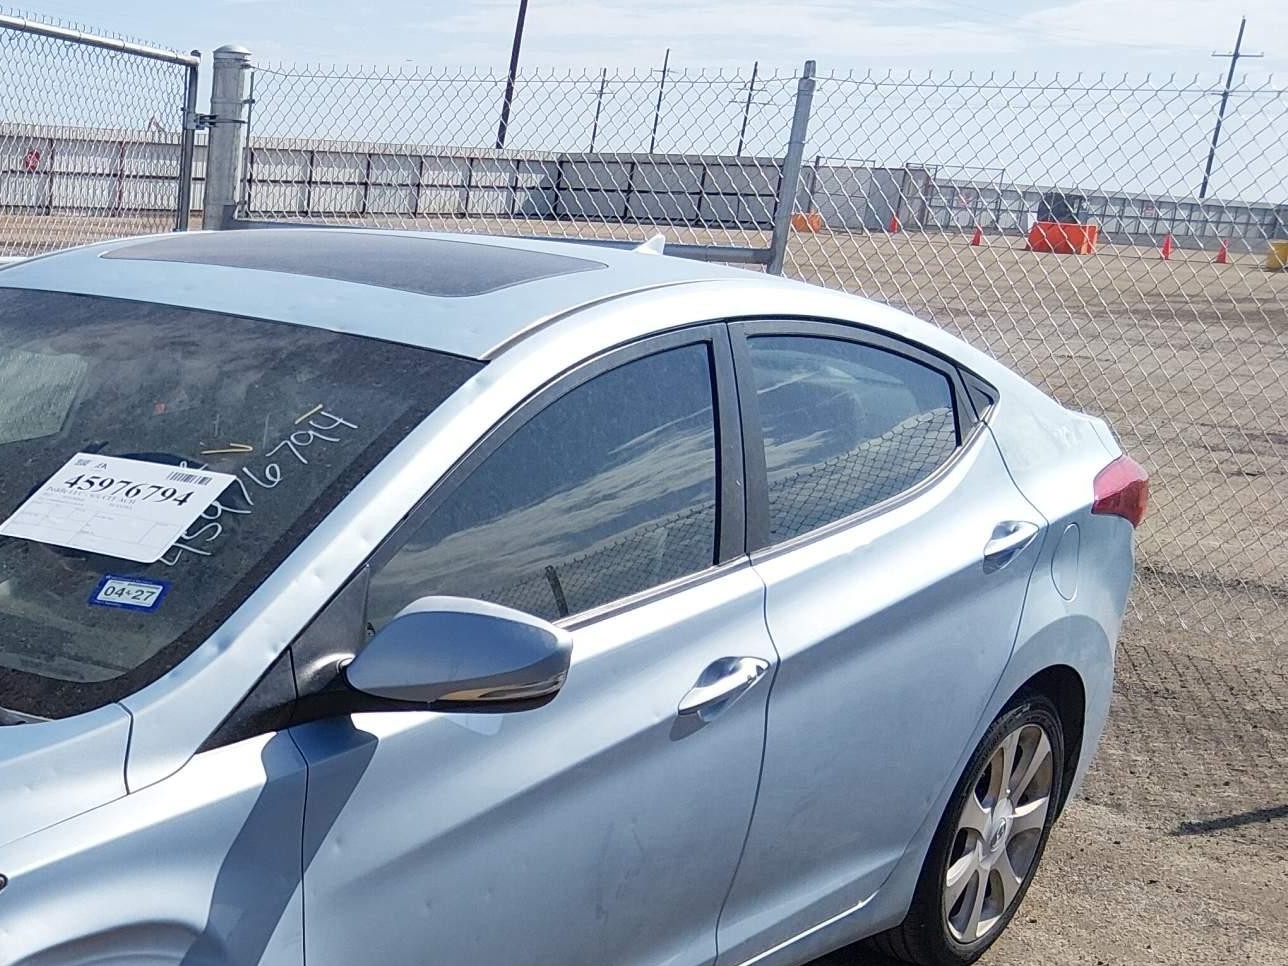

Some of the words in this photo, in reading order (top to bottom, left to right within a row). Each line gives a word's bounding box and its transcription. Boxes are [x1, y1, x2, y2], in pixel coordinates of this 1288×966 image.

[64, 473, 195, 507] 45976794
[103, 585, 126, 598] 04
[131, 589, 157, 602] 27
